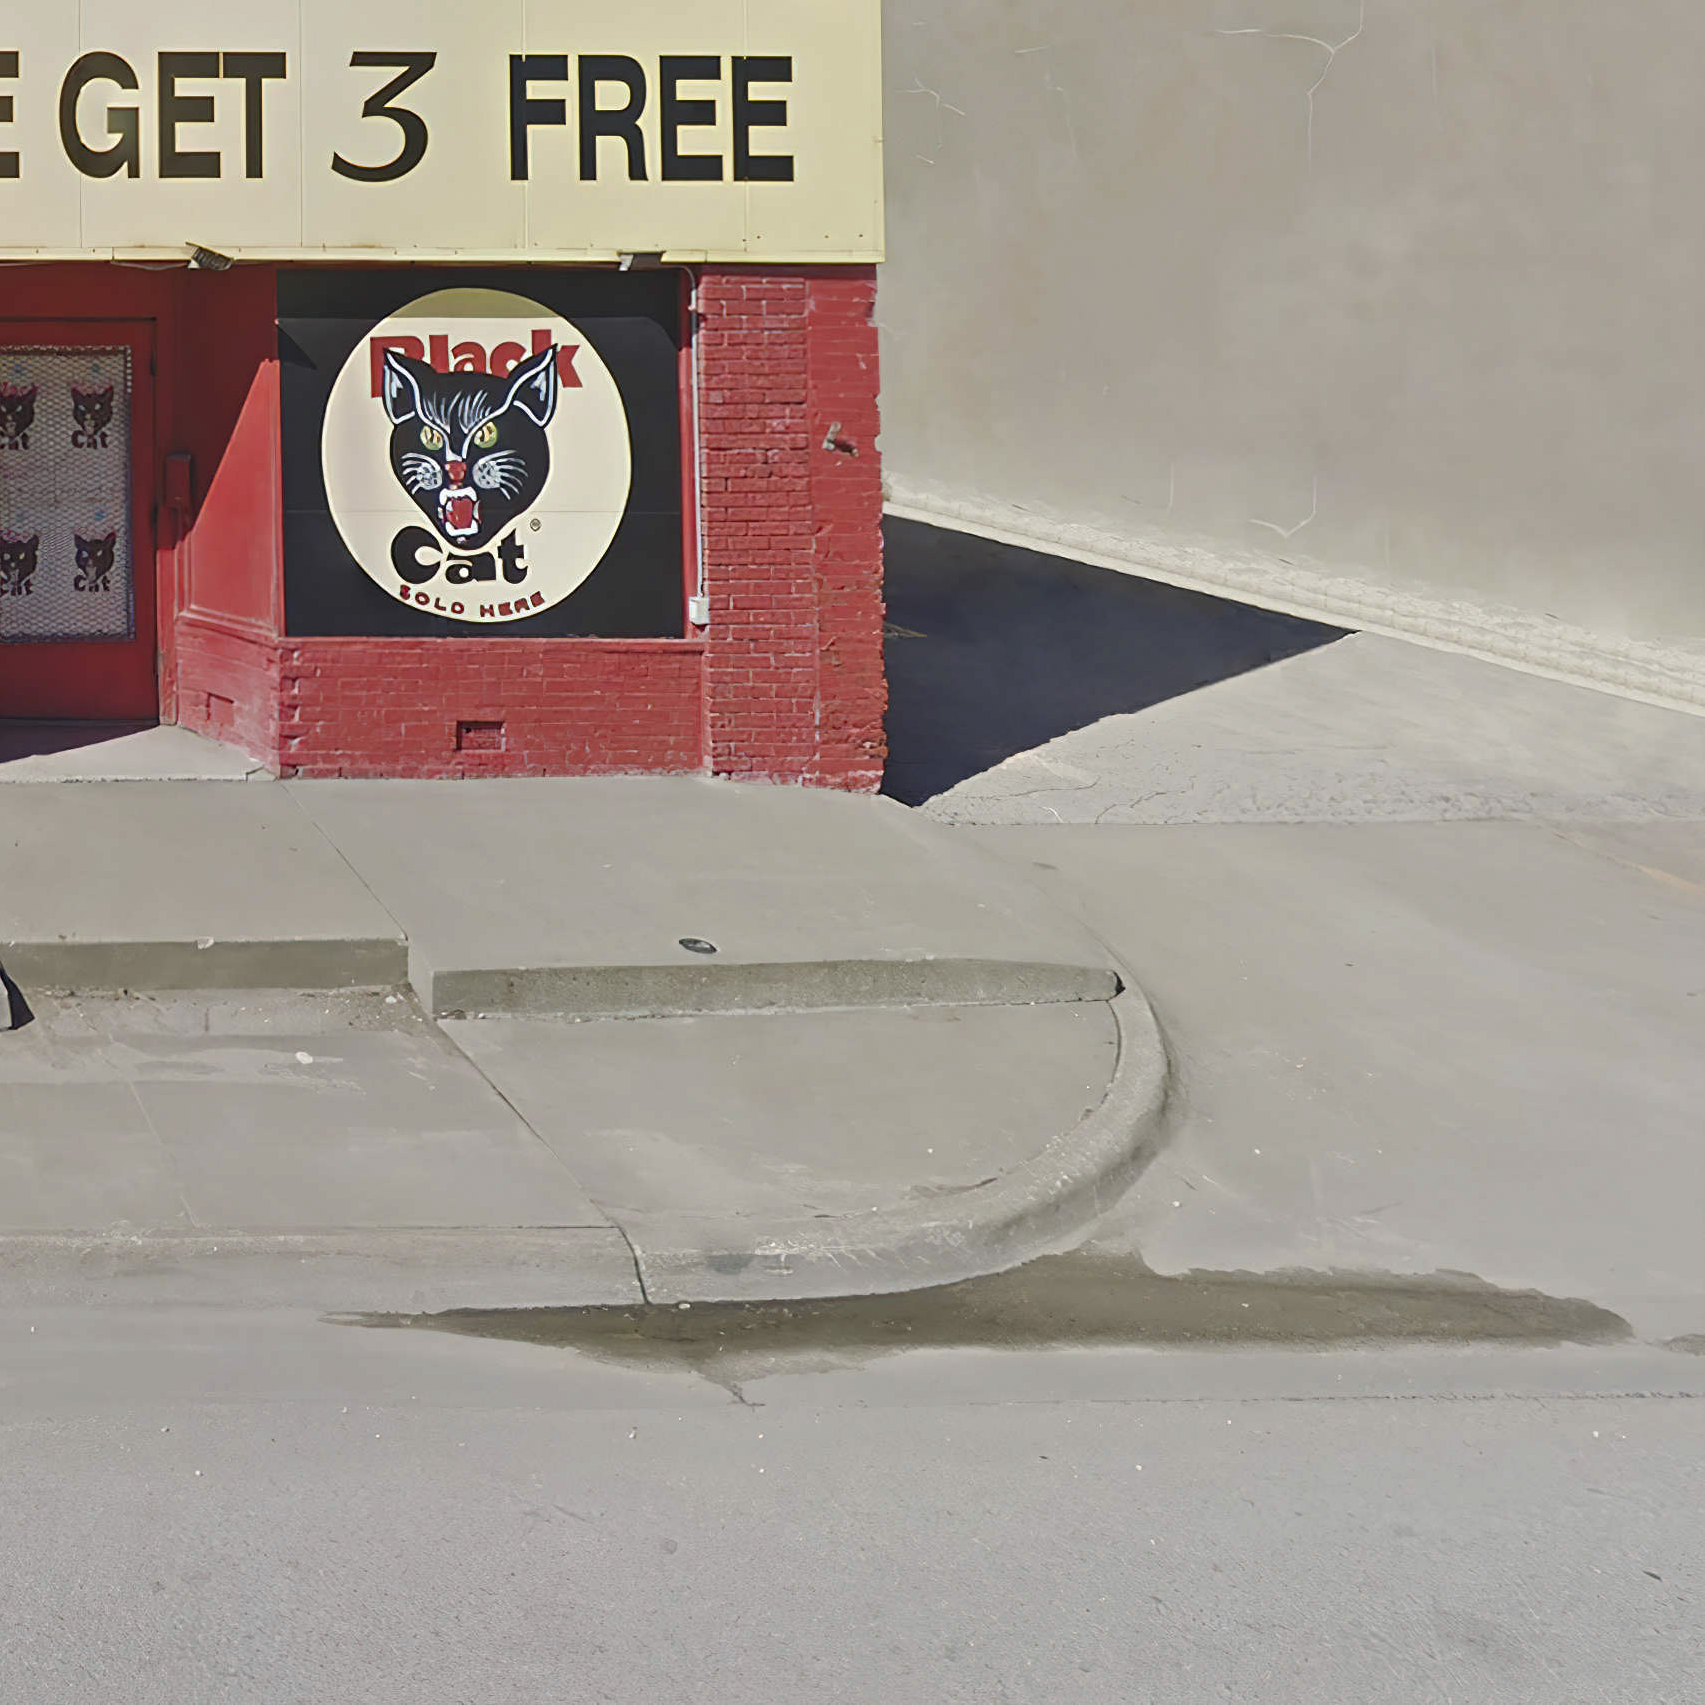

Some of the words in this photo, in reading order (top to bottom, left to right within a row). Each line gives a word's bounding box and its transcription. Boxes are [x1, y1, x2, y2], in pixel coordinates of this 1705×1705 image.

[59, 50, 287, 181] GET
[331, 51, 438, 182] 3
[509, 54, 795, 183] FREE
[391, 526, 528, 584] Cat
[400, 584, 465, 615] SOLD
[479, 591, 545, 618] HERE
